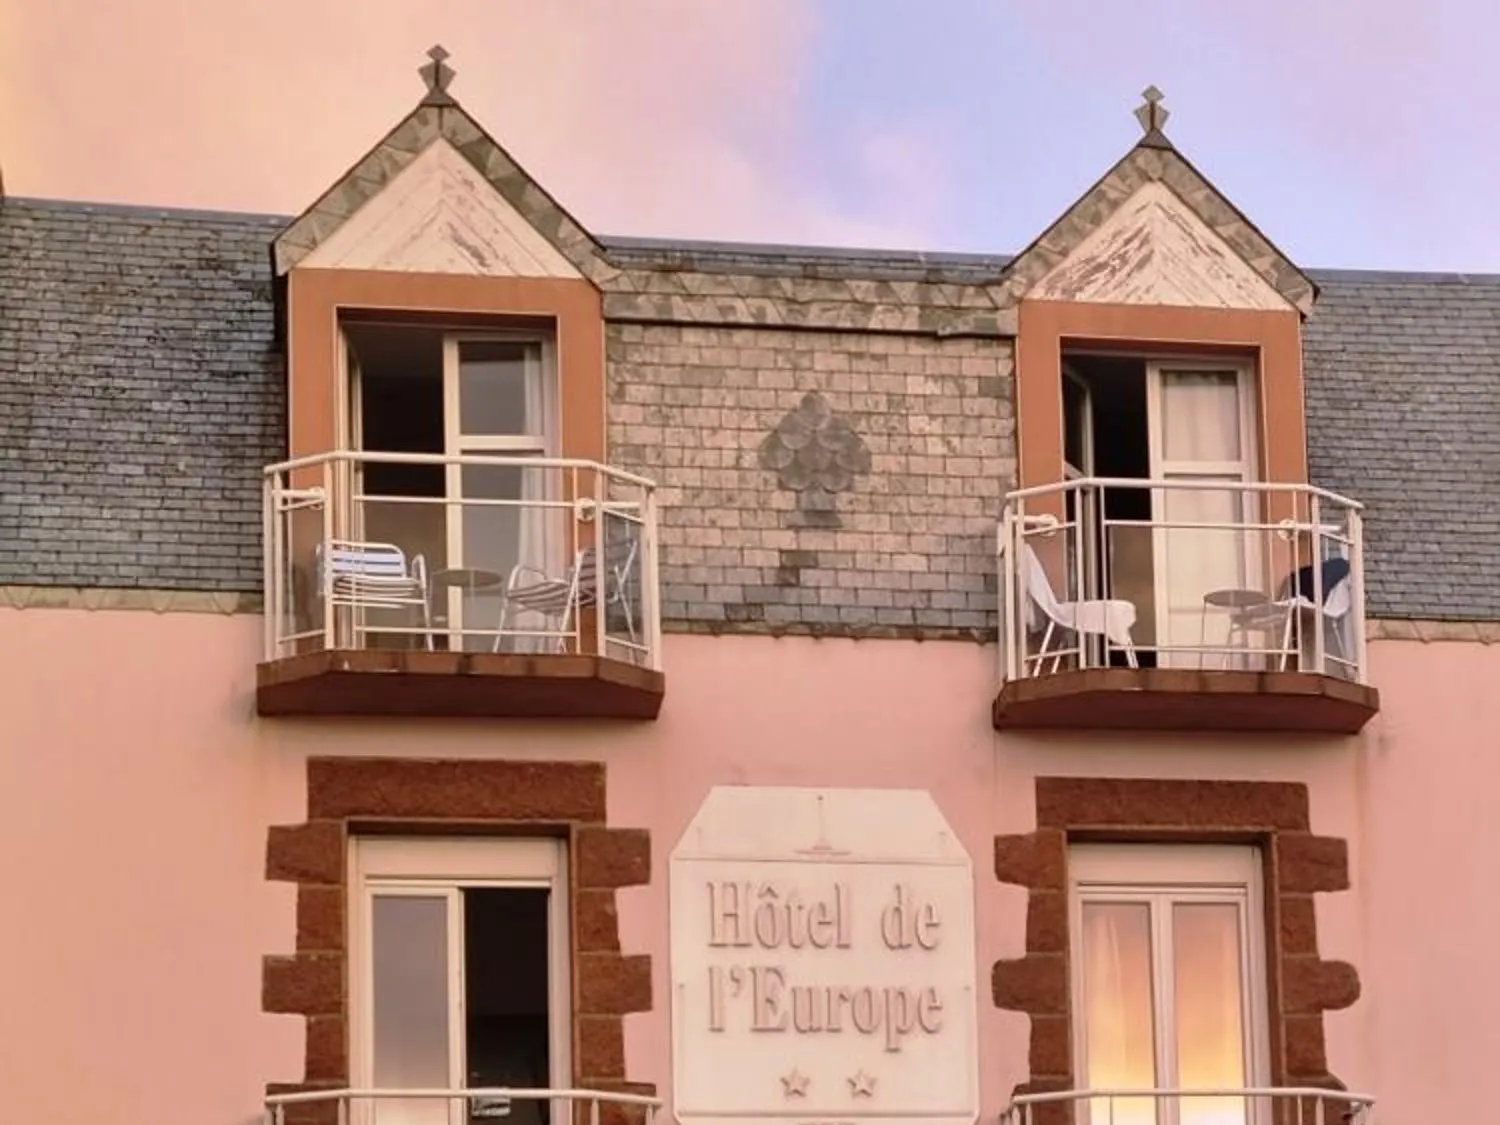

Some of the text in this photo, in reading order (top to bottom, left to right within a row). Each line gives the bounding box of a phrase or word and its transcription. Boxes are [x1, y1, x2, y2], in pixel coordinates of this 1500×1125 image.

[707, 880, 942, 951] Hôtel de
[707, 965, 944, 1053] l'Europe
